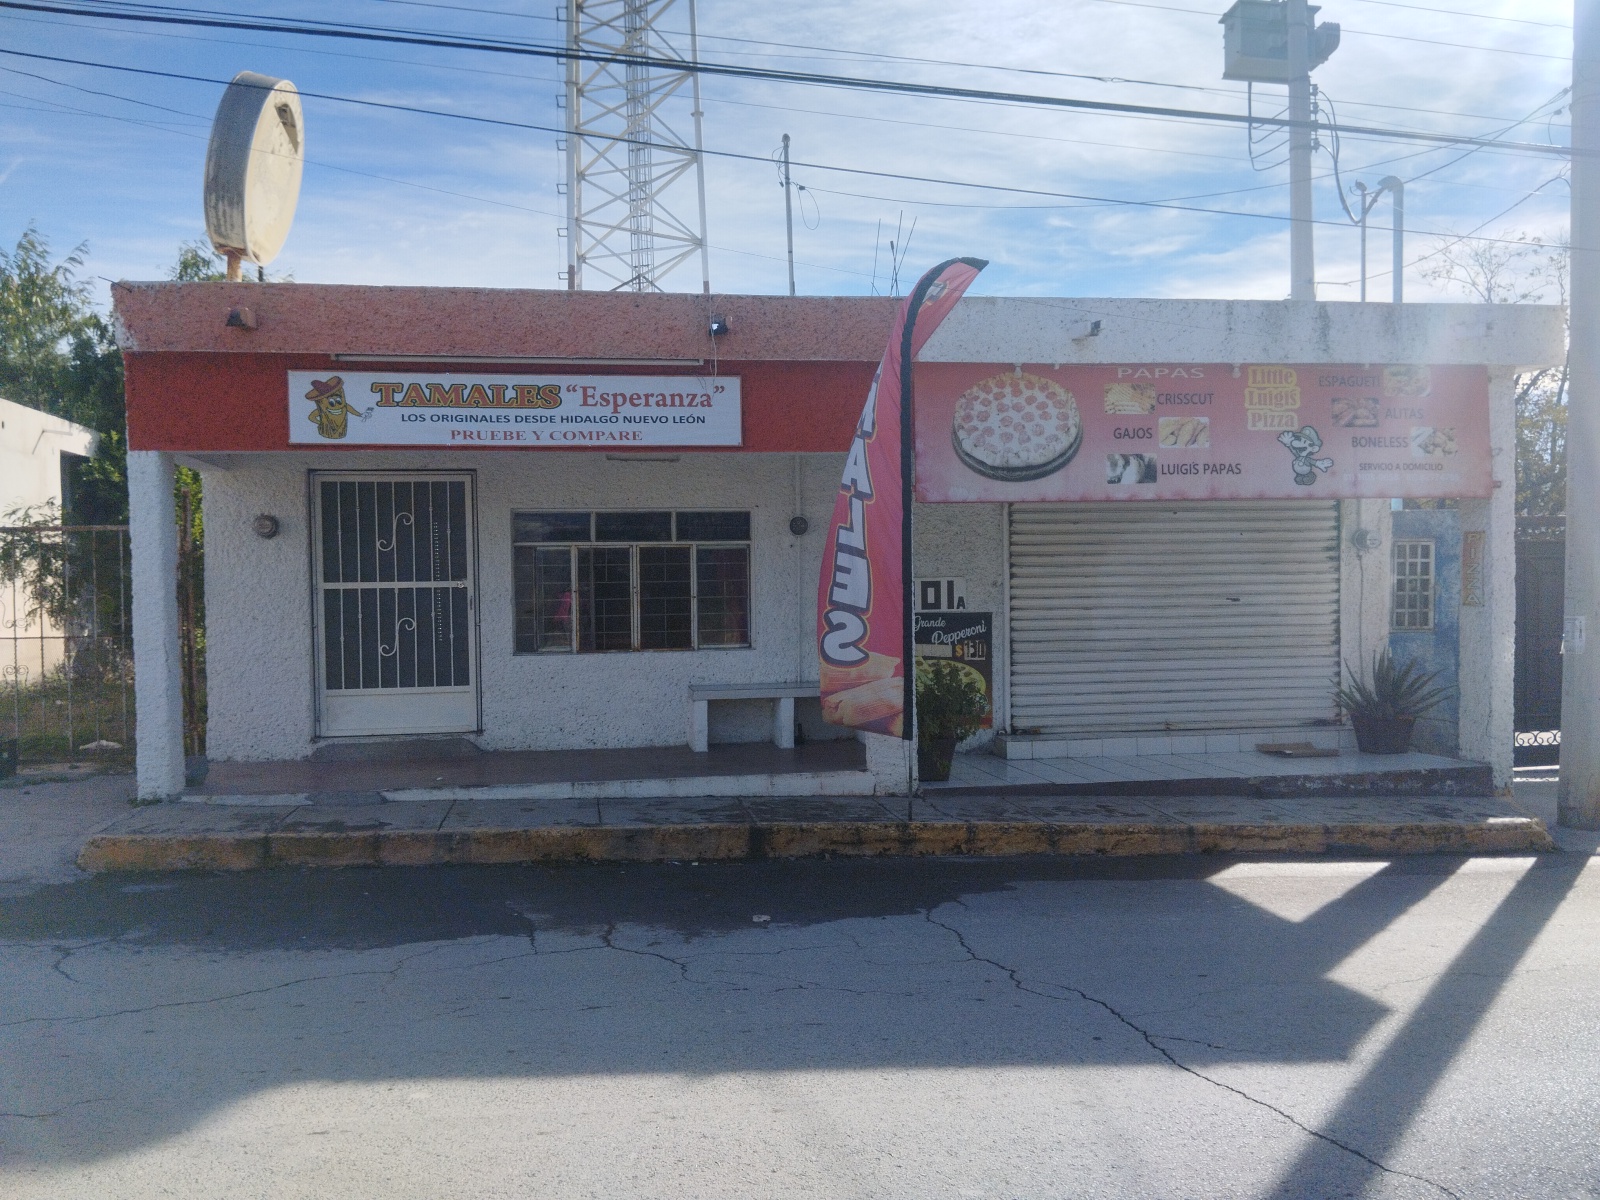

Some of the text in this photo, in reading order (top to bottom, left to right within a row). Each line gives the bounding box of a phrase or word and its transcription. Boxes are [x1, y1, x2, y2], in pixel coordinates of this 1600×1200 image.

[1117, 367, 1205, 379] PAPAS
[1251, 367, 1294, 386] Little
[1318, 375, 1381, 387] ESPAGUETI
[371, 382, 562, 409] TAMALES
[1157, 393, 1214, 405] CRISSCUT
[401, 412, 706, 425] LOS ORIGINALES DESDE HIDALGO NUEVO LEÓN
[1250, 411, 1296, 428] Pizza
[1385, 408, 1424, 419] ALITAS
[451, 429, 643, 441] PRUEBE Y COMPARE
[1113, 427, 1153, 440] GAJOS
[1351, 436, 1409, 448] BONELESS
[1202, 463, 1242, 475] PAPAS
[1359, 462, 1394, 471] SERVICIO
[1402, 463, 1444, 472] DOMICILIO
[1465, 532, 1481, 605] PIZZA
[931, 619, 987, 646] Pepperoni
